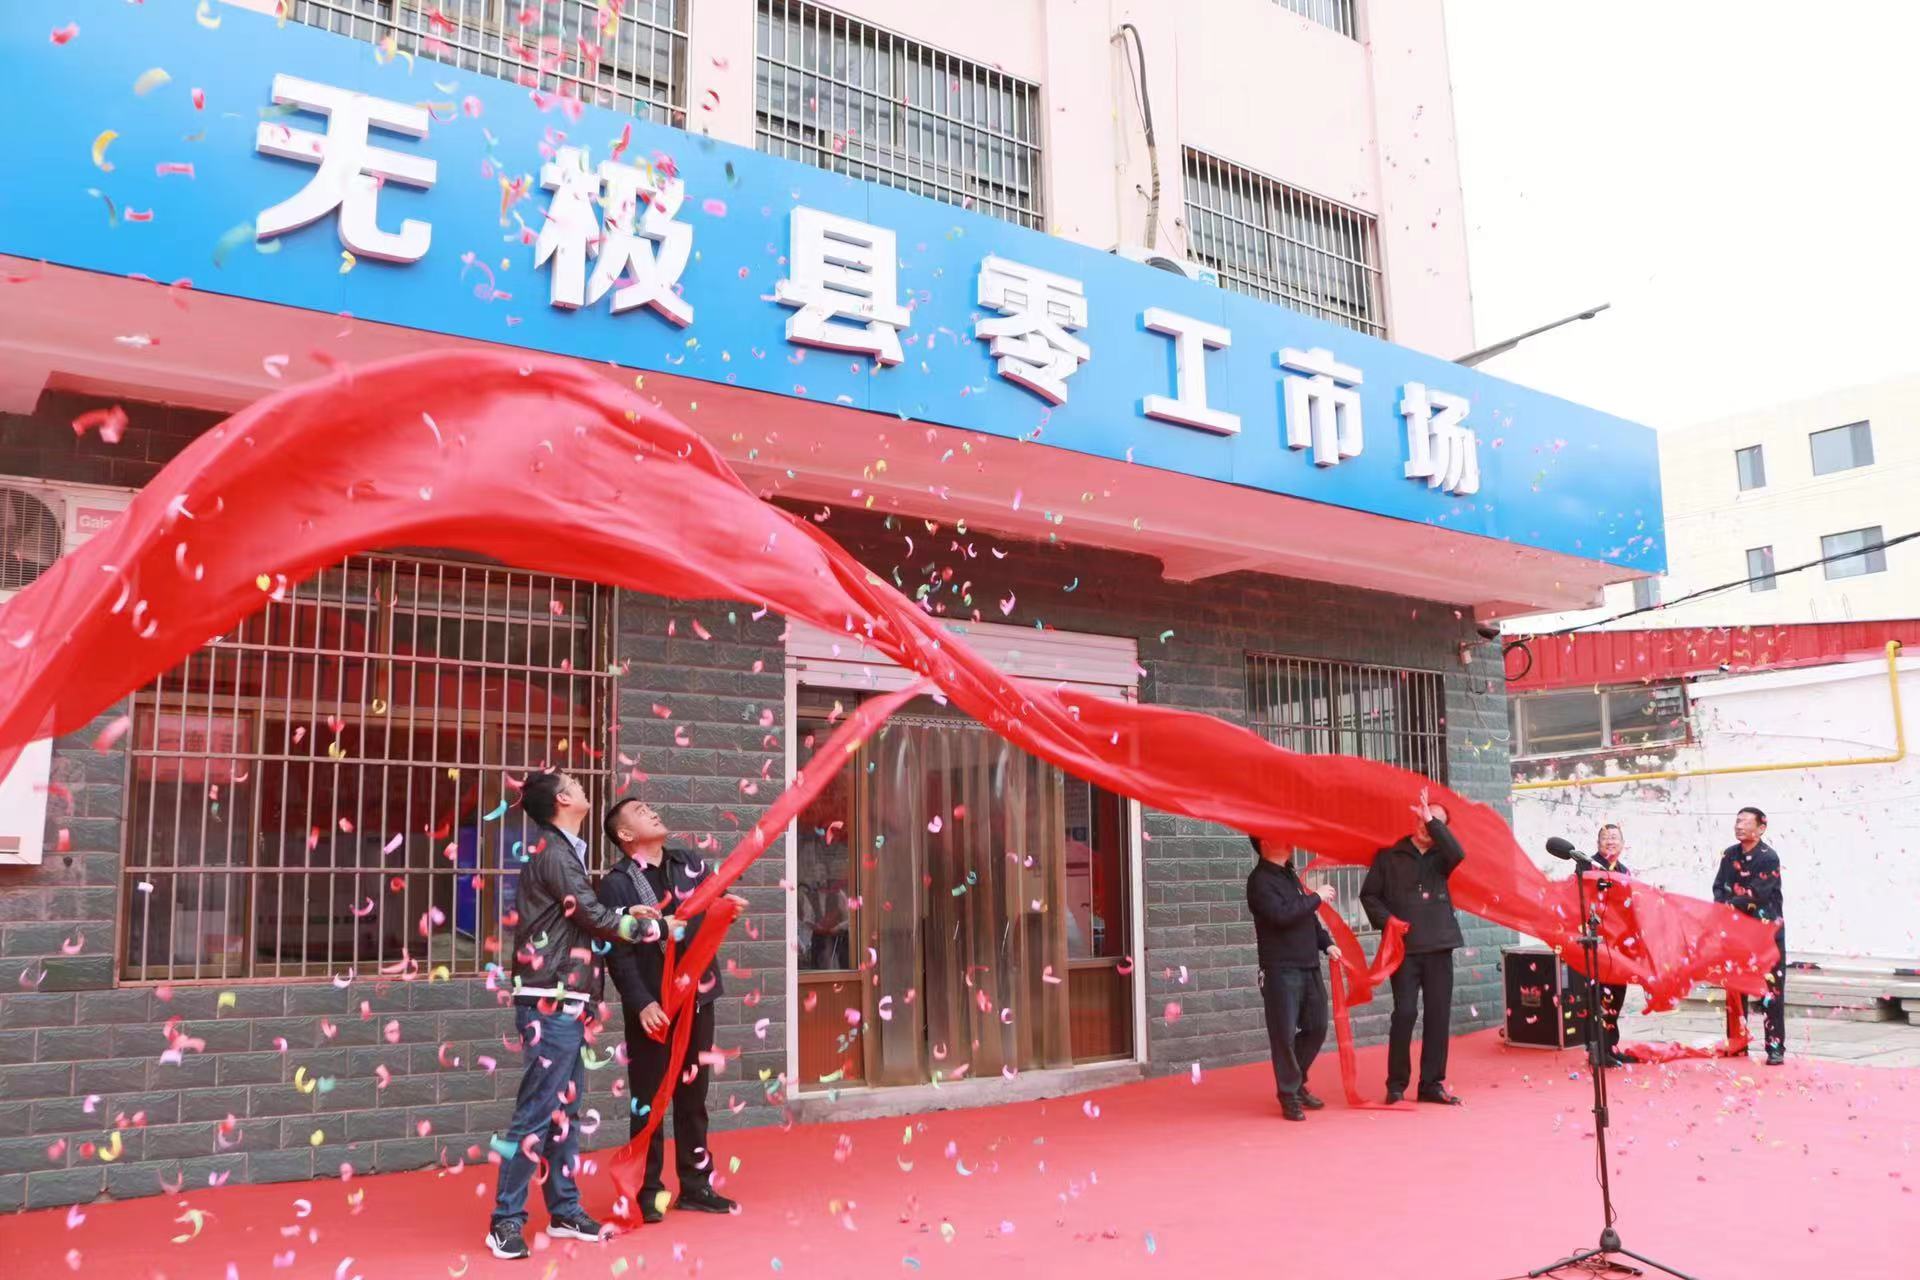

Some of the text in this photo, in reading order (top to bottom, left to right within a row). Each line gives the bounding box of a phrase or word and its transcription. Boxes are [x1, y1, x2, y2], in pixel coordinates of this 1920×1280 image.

[256, 73, 1480, 496] 无极县零工市场
